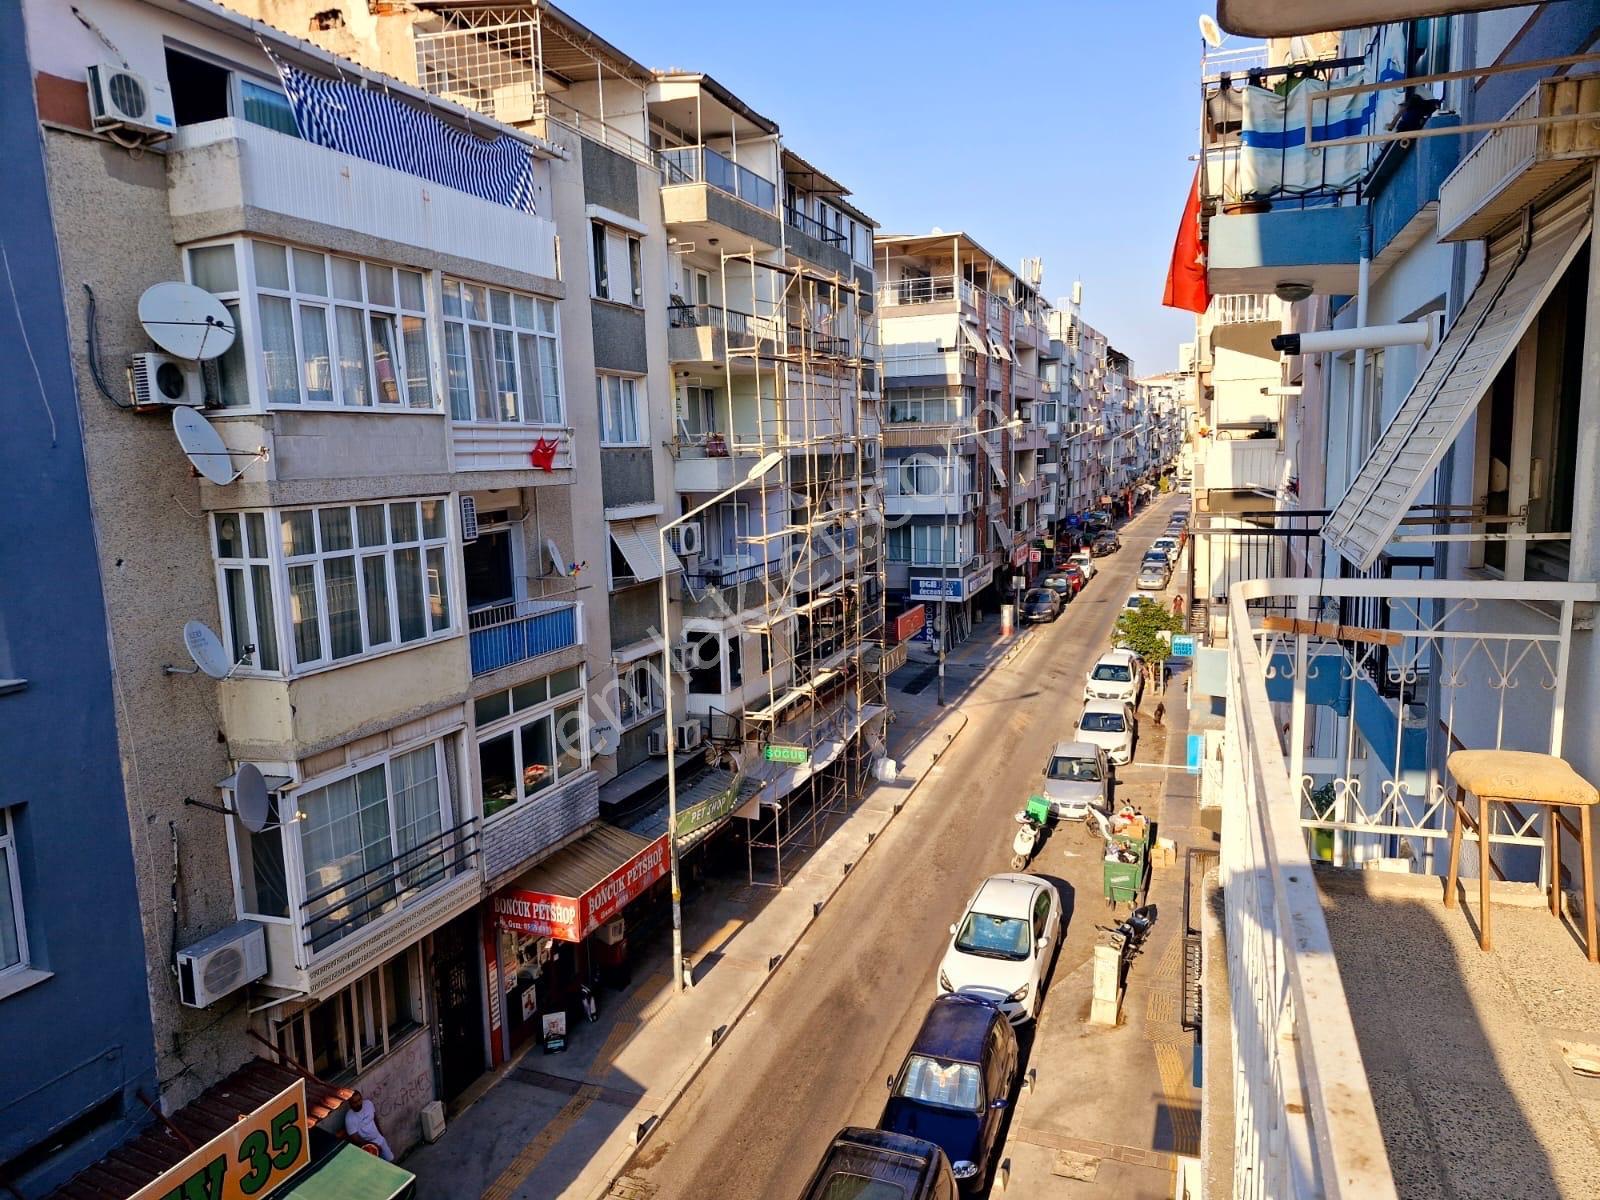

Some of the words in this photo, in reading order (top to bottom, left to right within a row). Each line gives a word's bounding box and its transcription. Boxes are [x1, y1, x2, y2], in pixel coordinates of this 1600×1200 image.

[495, 897, 531, 918] BONCUK
[532, 901, 576, 926] PETSHOP
[588, 876, 626, 914] BONCUK
[627, 848, 664, 887] PETSHOP
[238, 1103, 302, 1195] 35
